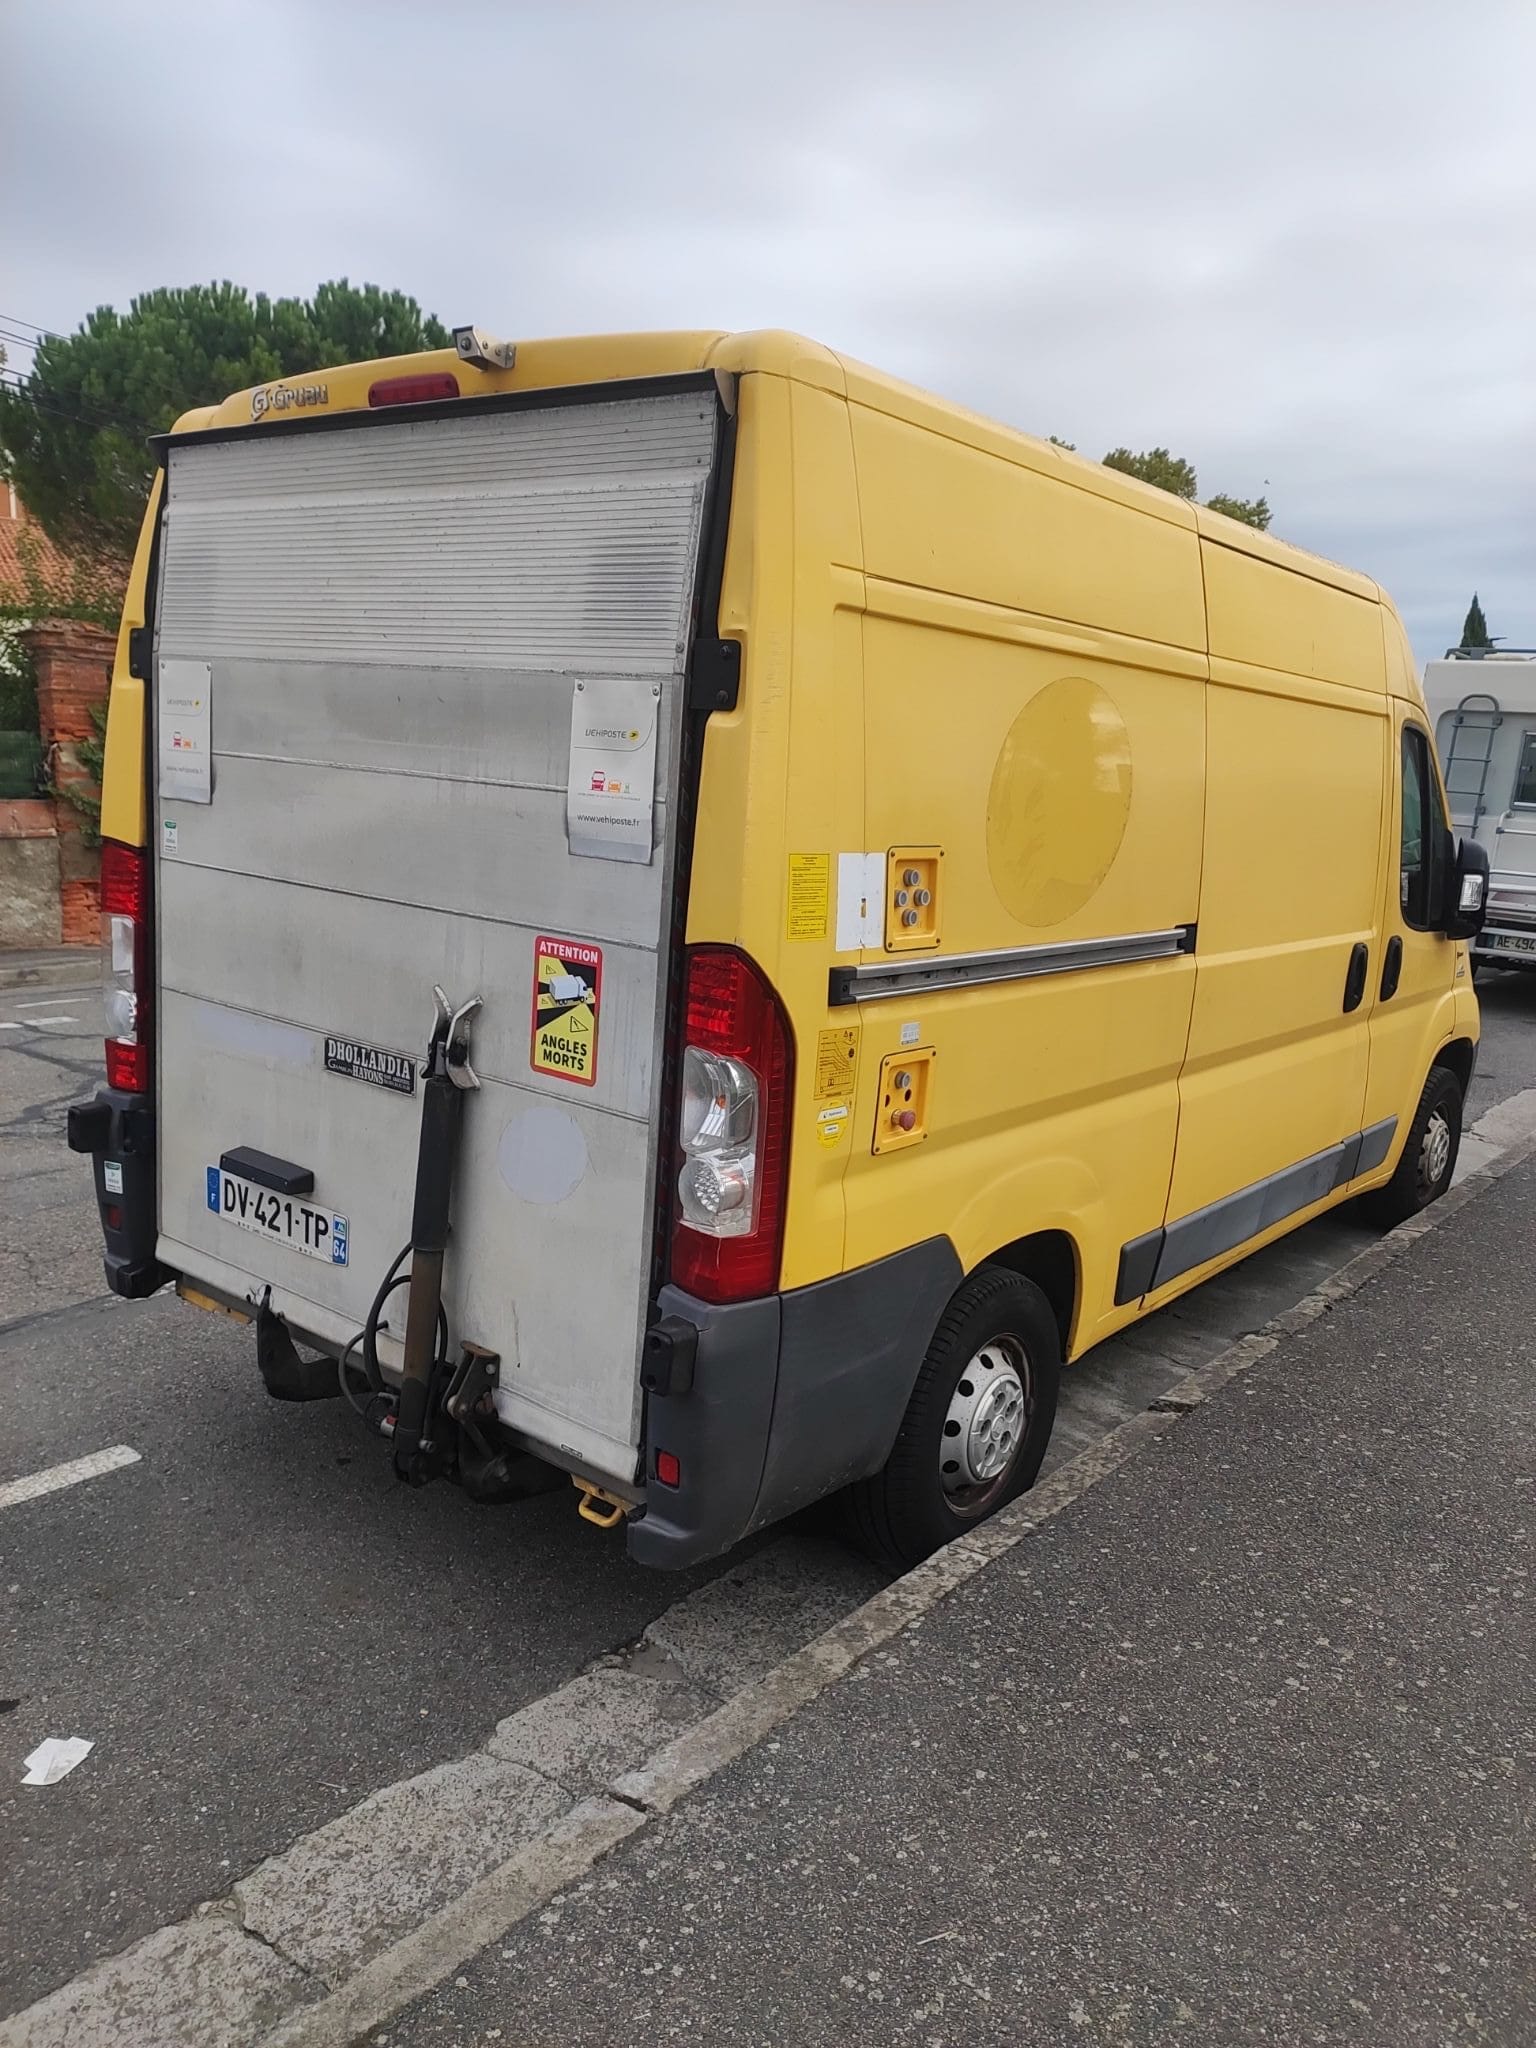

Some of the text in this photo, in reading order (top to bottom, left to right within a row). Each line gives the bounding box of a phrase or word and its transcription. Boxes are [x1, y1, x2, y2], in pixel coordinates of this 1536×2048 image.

[577, 814, 640, 827] www.vehiposte.fr
[539, 940, 598, 963] ATTENTION
[541, 1033, 587, 1057] ANGLES
[327, 1039, 411, 1080] DHOLLANDIA
[543, 1048, 584, 1072] MORTS
[352, 1064, 384, 1085] HAYONS
[210, 1192, 217, 1203] F
[223, 1178, 330, 1249] DV-421-TP
[332, 1239, 346, 1260] 64
